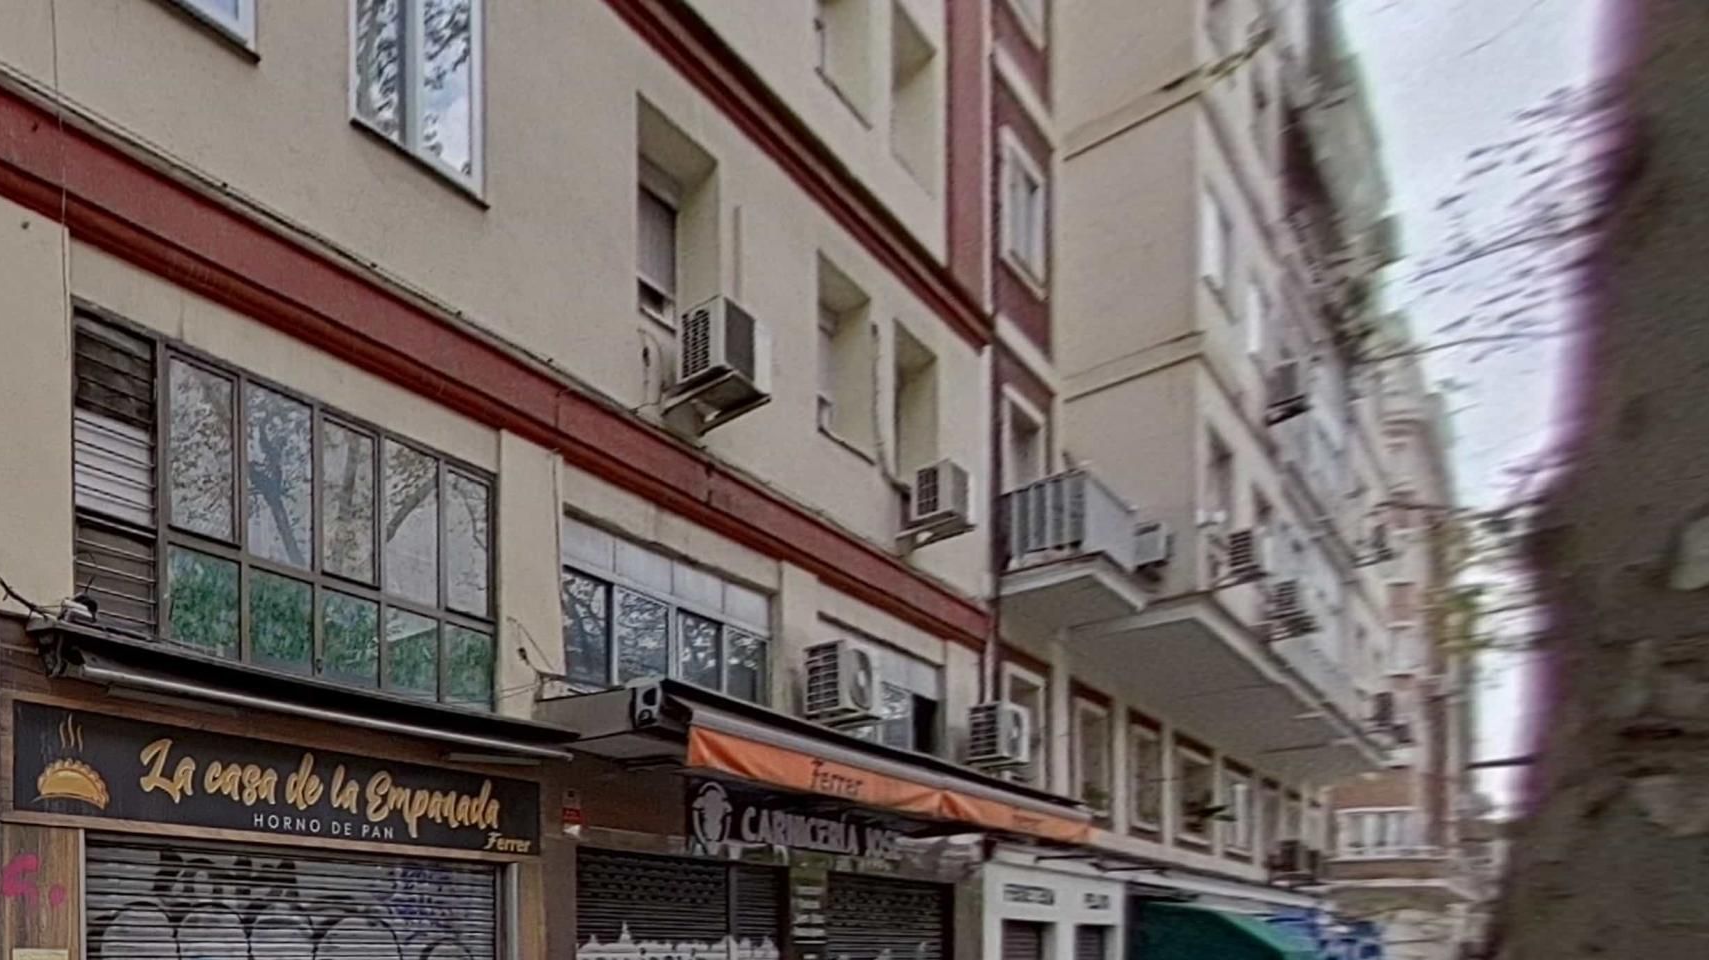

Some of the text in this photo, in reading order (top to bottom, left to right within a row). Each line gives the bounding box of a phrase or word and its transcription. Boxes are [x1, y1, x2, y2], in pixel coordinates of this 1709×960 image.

[139, 737, 501, 839] La casa de la Empanada
[810, 758, 864, 796] Ferrer
[253, 813, 395, 839] HORNO DE PAN
[483, 832, 532, 853] Ferrer
